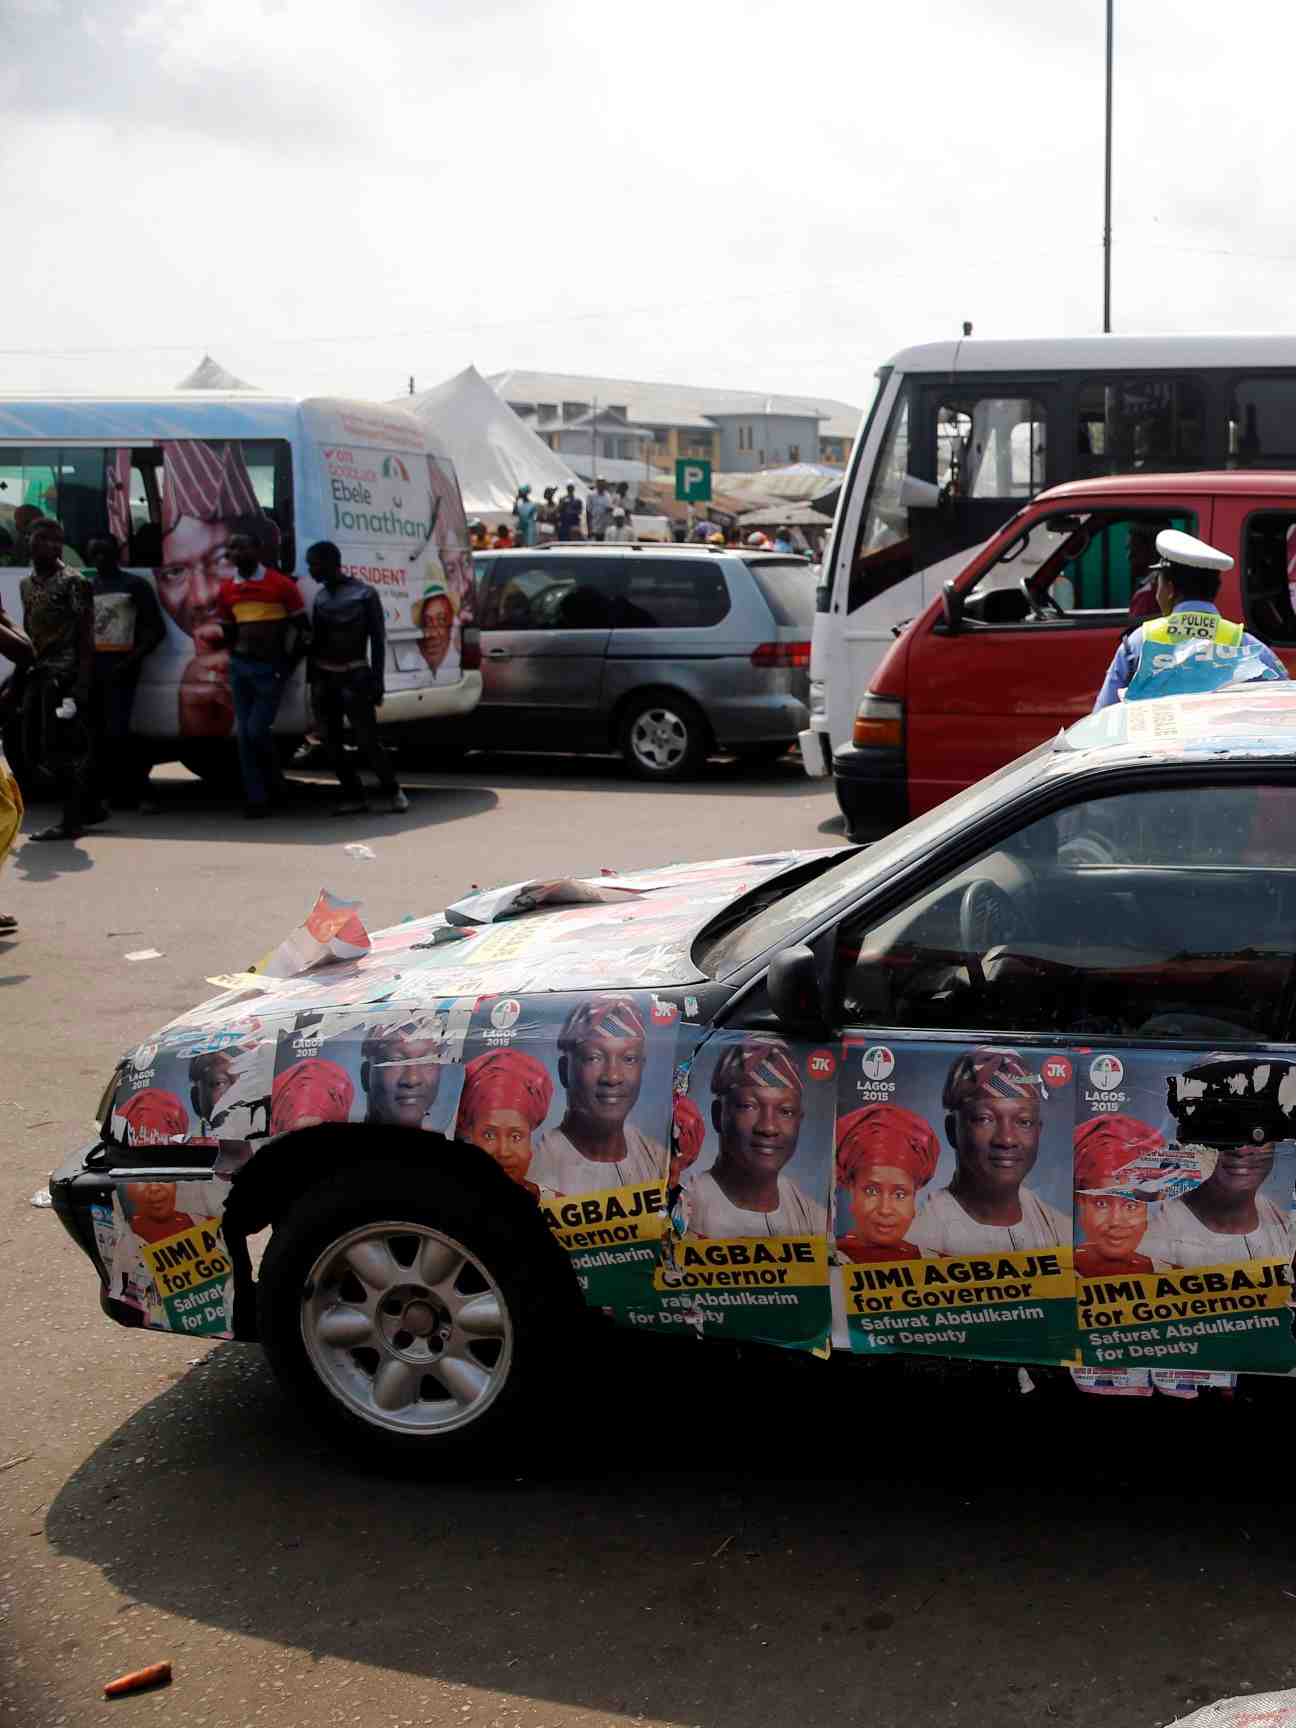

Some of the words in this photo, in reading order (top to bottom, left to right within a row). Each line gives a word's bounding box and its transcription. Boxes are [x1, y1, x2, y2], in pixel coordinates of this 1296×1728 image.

[331, 479, 371, 504] Ebele
[684, 466, 704, 493] P
[334, 502, 427, 538] Jonathan
[1180, 614, 1216, 628] POLICE
[857, 1081, 896, 1092] LAGOS
[863, 1091, 888, 1102] 2015
[1085, 1091, 1126, 1102] LAGOS
[1091, 1101, 1119, 1112] 2015
[543, 1189, 662, 1229] AGBAJE
[558, 1224, 638, 1249] vernor
[152, 1238, 200, 1273] JIMI
[571, 1248, 655, 1270] bdulkarim
[684, 1242, 815, 1267] AGBAJE
[163, 1270, 193, 1294] for
[850, 1265, 914, 1293] JIMI
[923, 1254, 1062, 1286] AGBAJE
[1079, 1280, 1146, 1307] JIMI
[1155, 1264, 1290, 1299] AGBAJE
[694, 1291, 799, 1308] Abdulkarim
[854, 1294, 893, 1313] for
[901, 1282, 1033, 1309] Governor
[181, 1313, 204, 1330] for
[628, 1311, 655, 1325] for
[861, 1314, 930, 1331] Safurat
[935, 1306, 1045, 1327] Abdulkarim
[1081, 1308, 1124, 1328] for
[1132, 1293, 1267, 1321] Governor
[868, 1332, 896, 1348] for
[900, 1329, 967, 1344] Deputy
[1089, 1328, 1160, 1346] Safurat
[1166, 1315, 1280, 1338] Abdulkarim
[1096, 1345, 1124, 1361] for
[1129, 1341, 1199, 1357] Deputy
